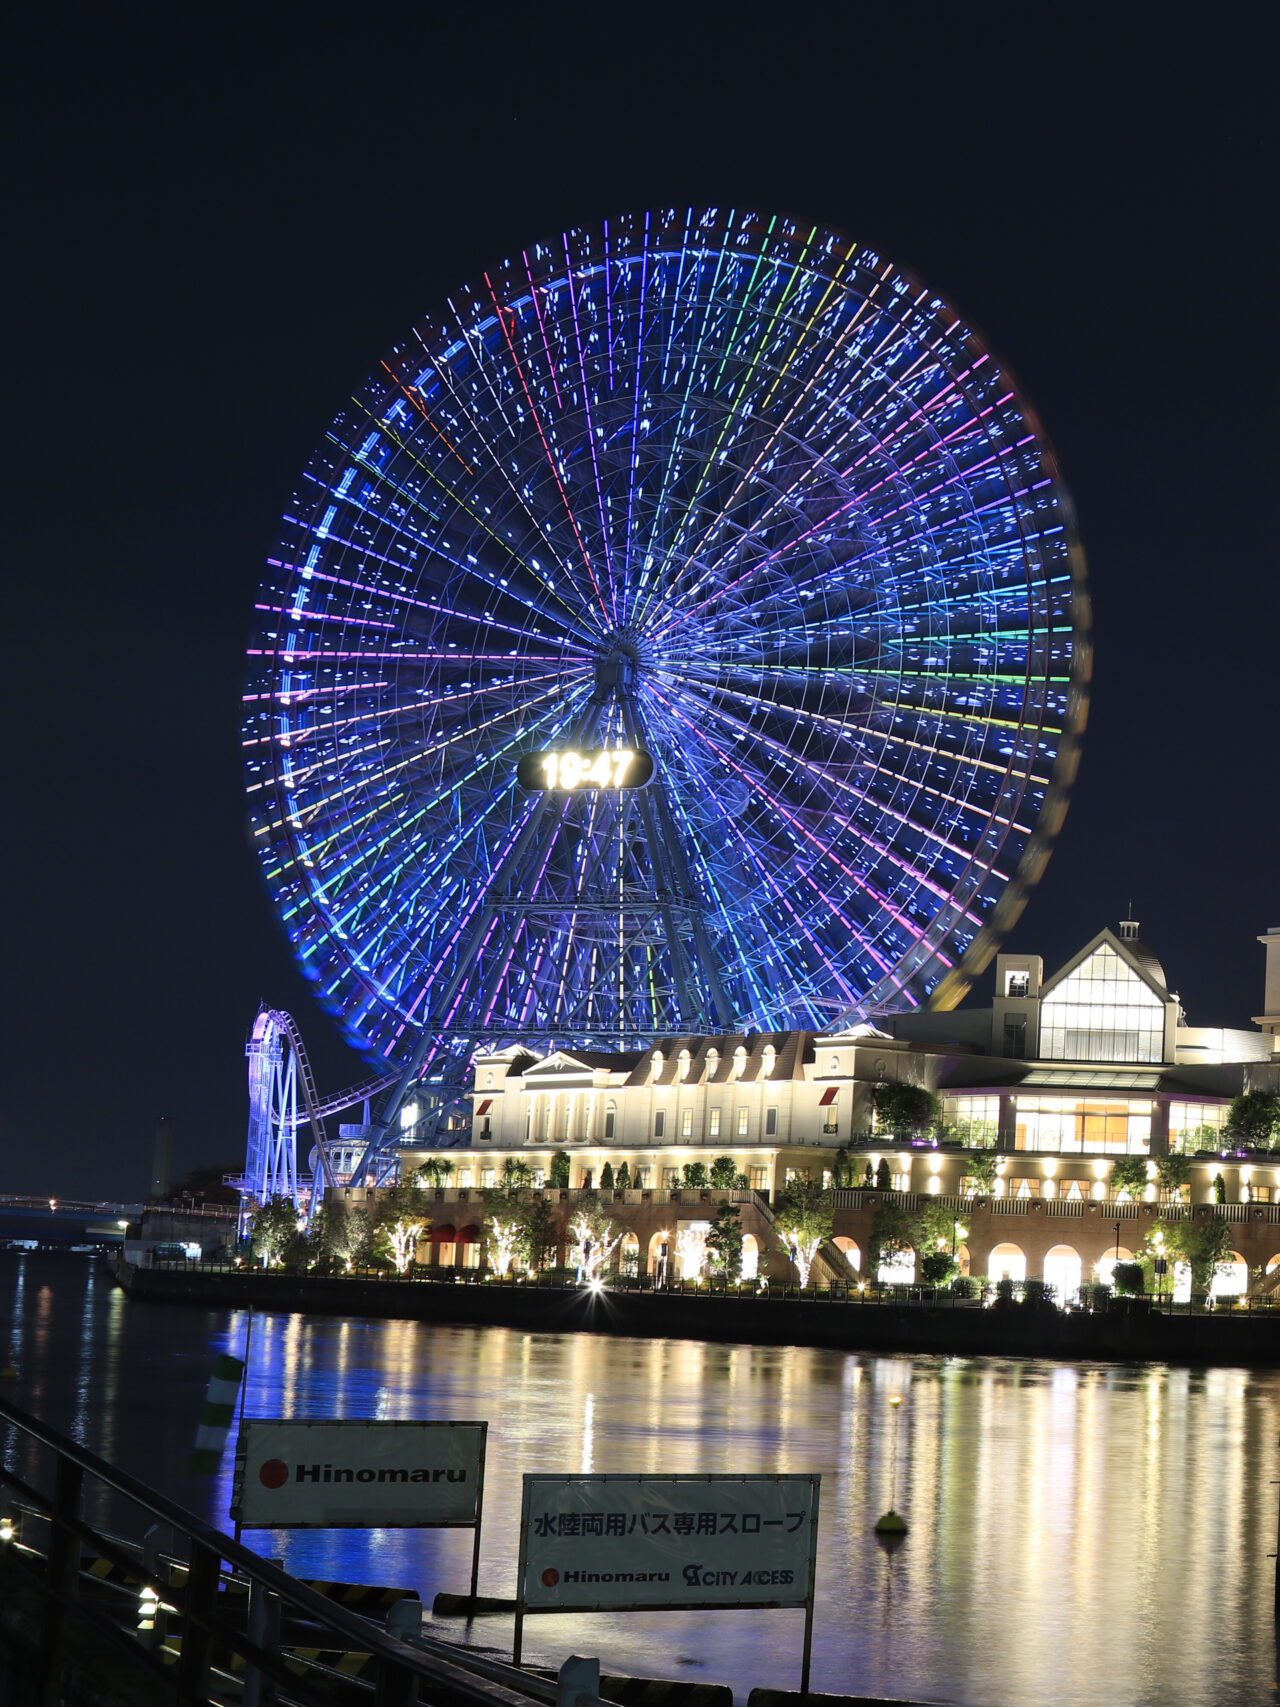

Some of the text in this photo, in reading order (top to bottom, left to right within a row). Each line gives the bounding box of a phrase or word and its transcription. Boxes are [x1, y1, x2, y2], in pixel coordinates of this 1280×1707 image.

[296, 1464, 466, 1483] Hinomaru
[534, 1510, 807, 1537] 水陸両用バス専用スロープ
[564, 1571, 670, 1583] Hinomaru
[702, 1571, 738, 1586] CITY
[739, 1570, 794, 1586] ACCESS
